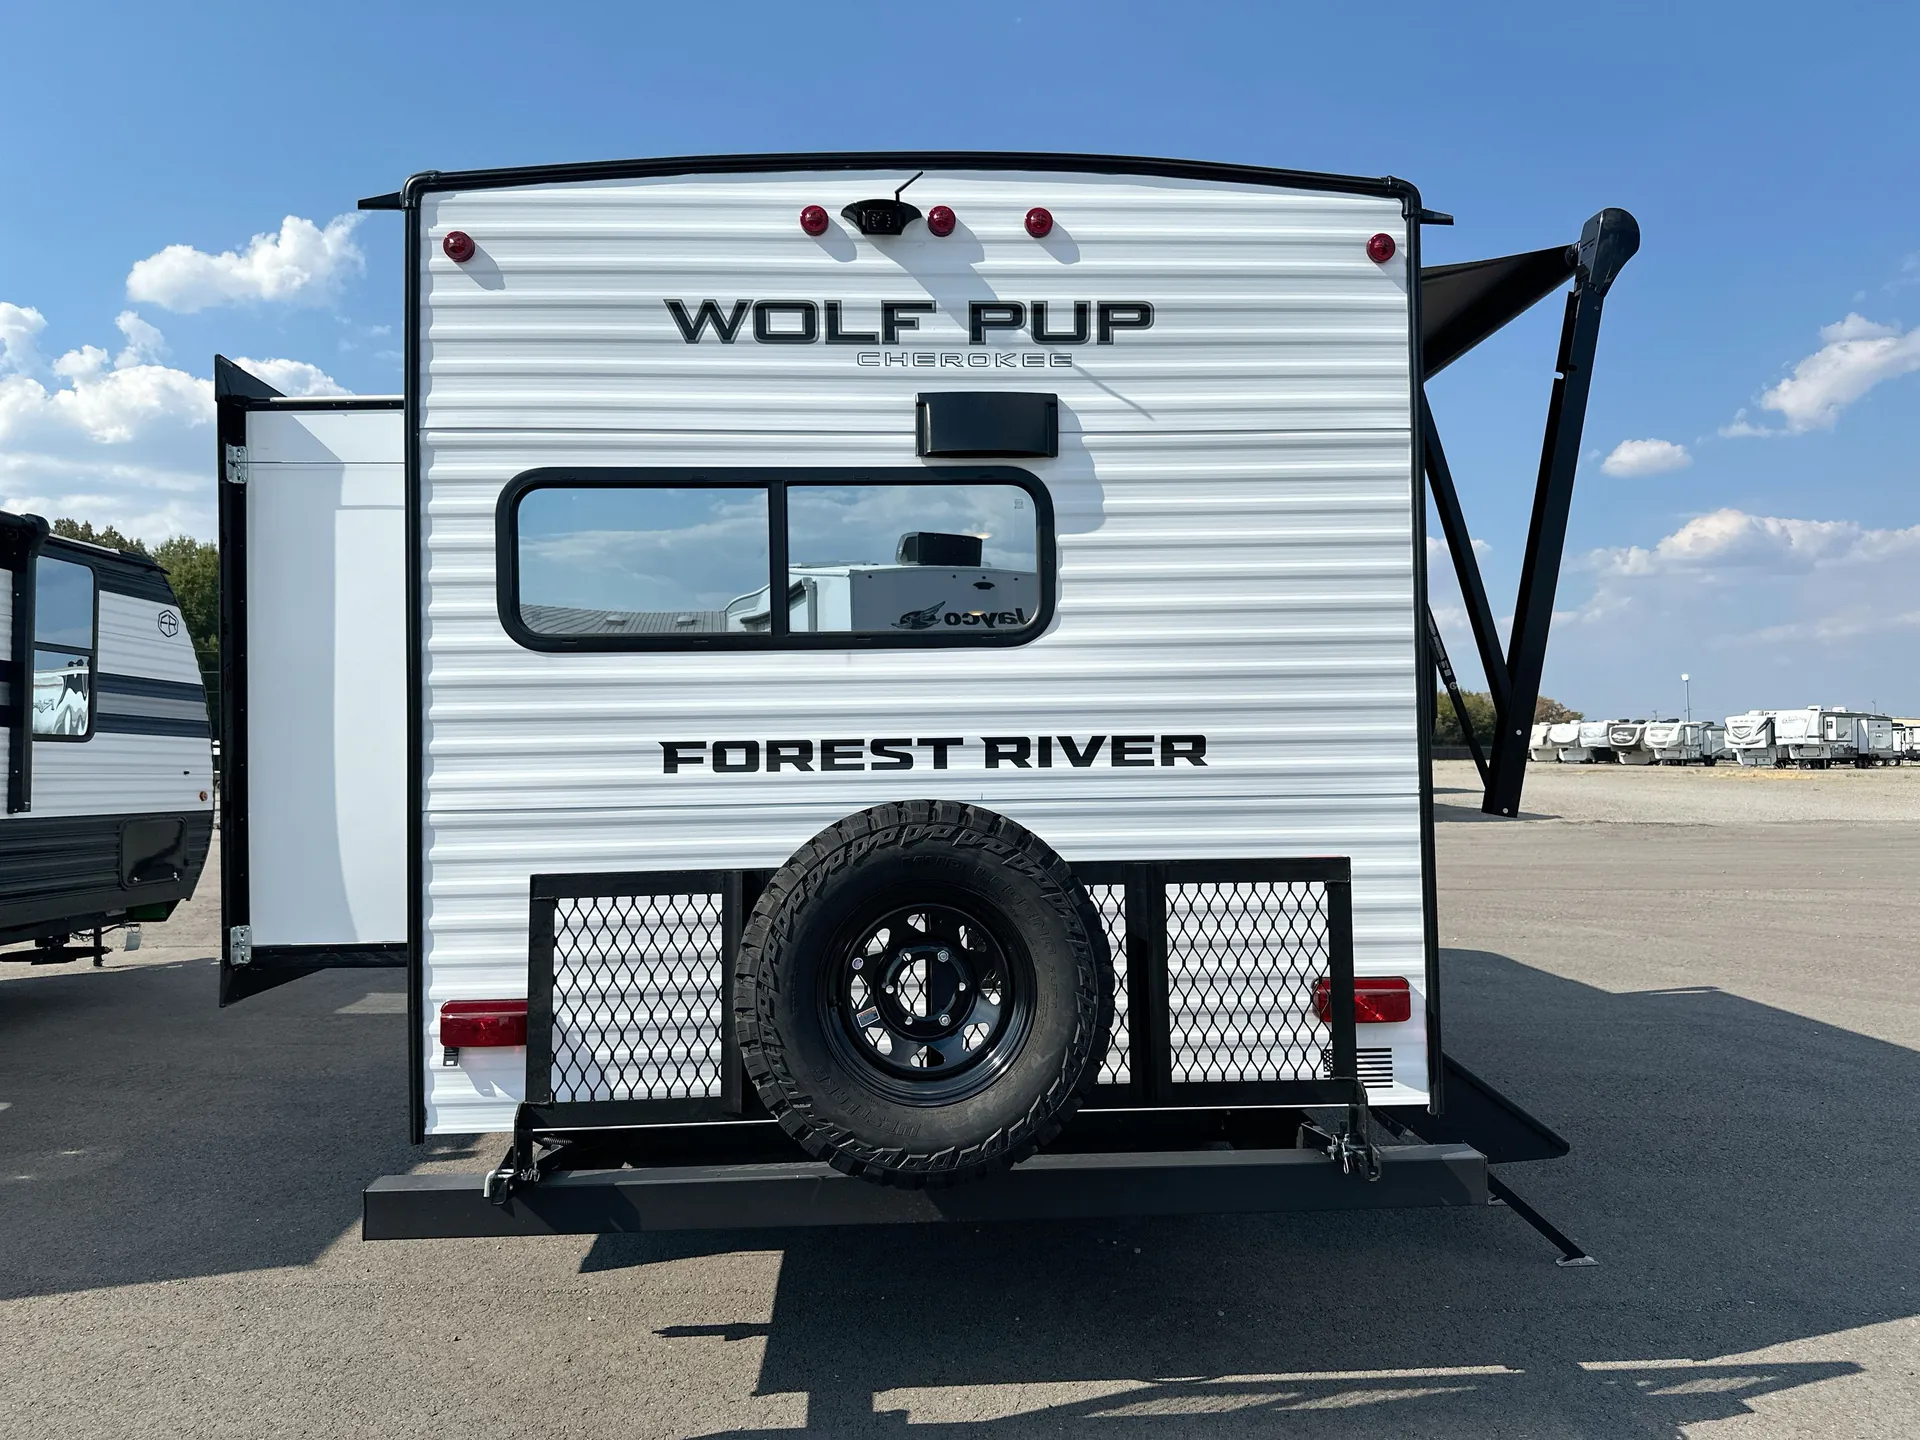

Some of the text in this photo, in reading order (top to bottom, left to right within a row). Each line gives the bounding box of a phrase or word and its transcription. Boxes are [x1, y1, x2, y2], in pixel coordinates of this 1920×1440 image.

[662, 299, 1155, 346] WOLF PUP
[856, 351, 1073, 368] CHEROKEE
[657, 734, 1208, 774] FOREST RIVER
